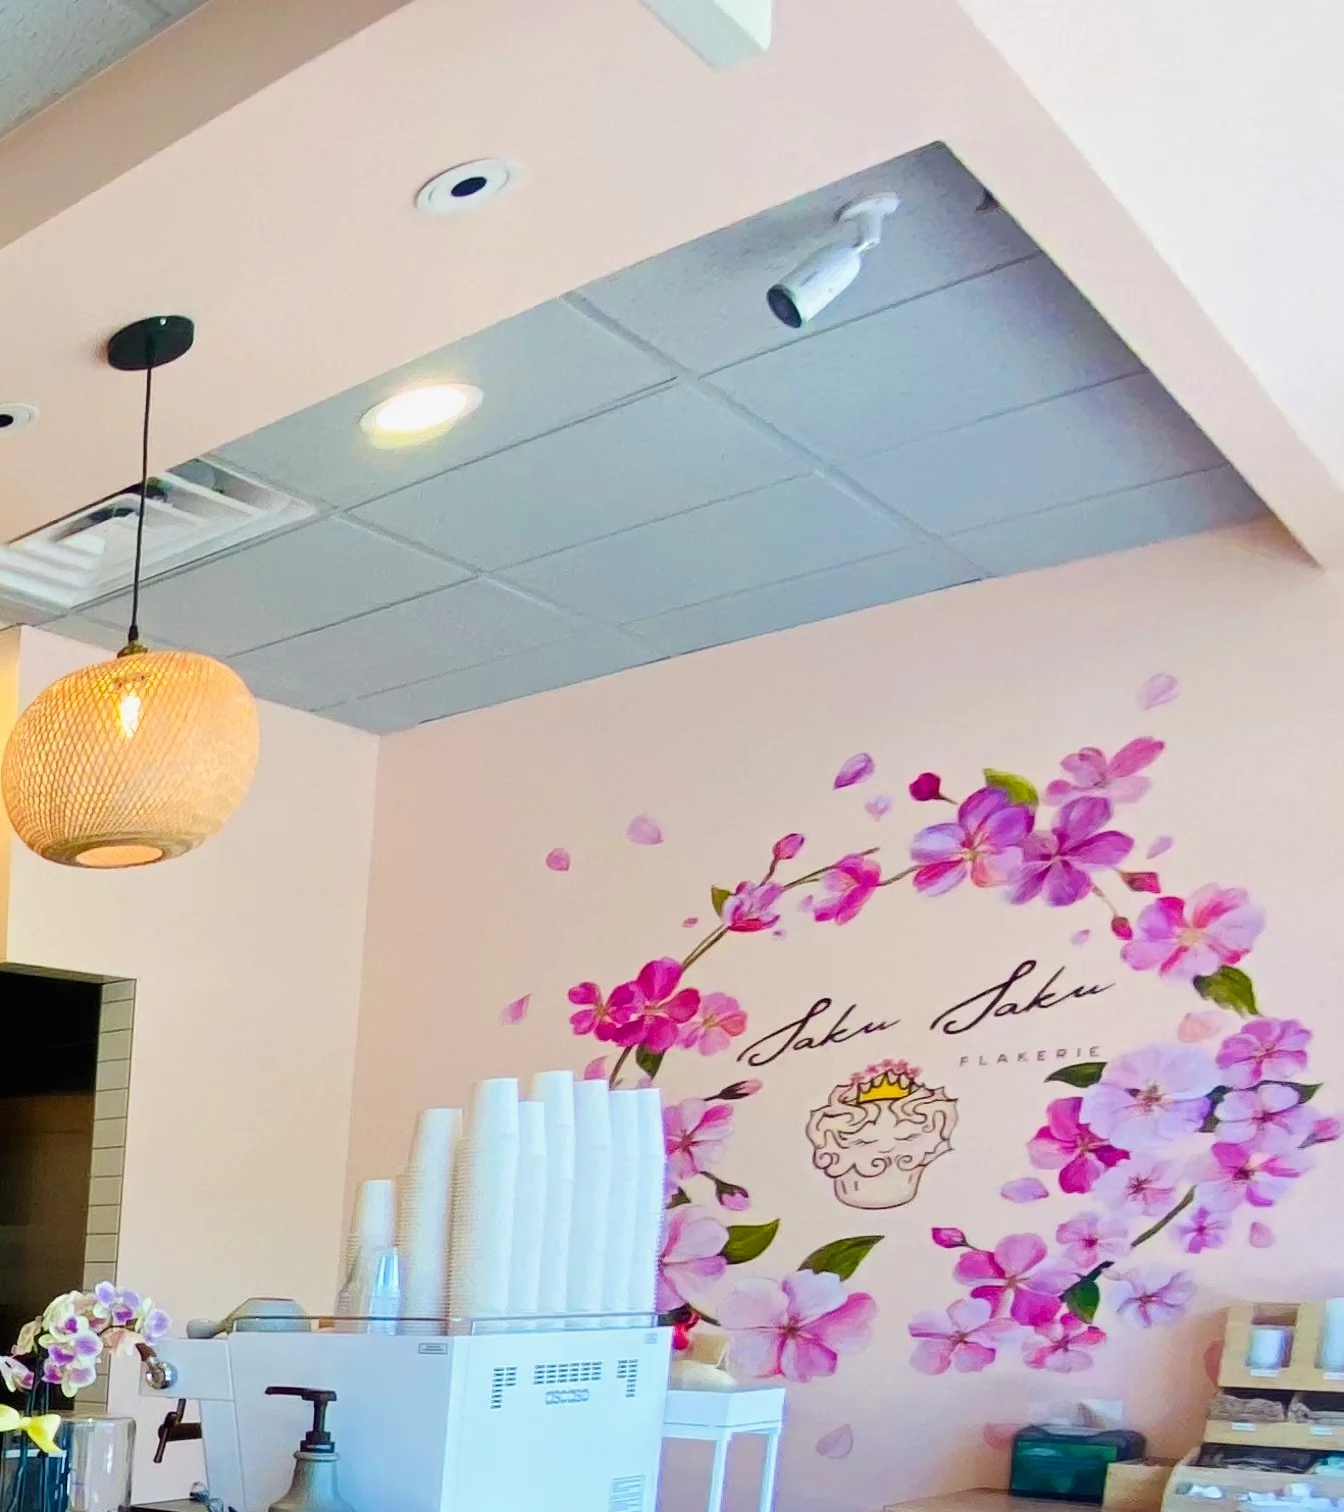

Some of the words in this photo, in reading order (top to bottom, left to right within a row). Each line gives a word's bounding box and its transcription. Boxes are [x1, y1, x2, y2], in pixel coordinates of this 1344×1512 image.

[736, 997, 901, 1067] Saku
[929, 959, 1116, 1035] Saku
[959, 1045, 1101, 1068] FLAKERIE
